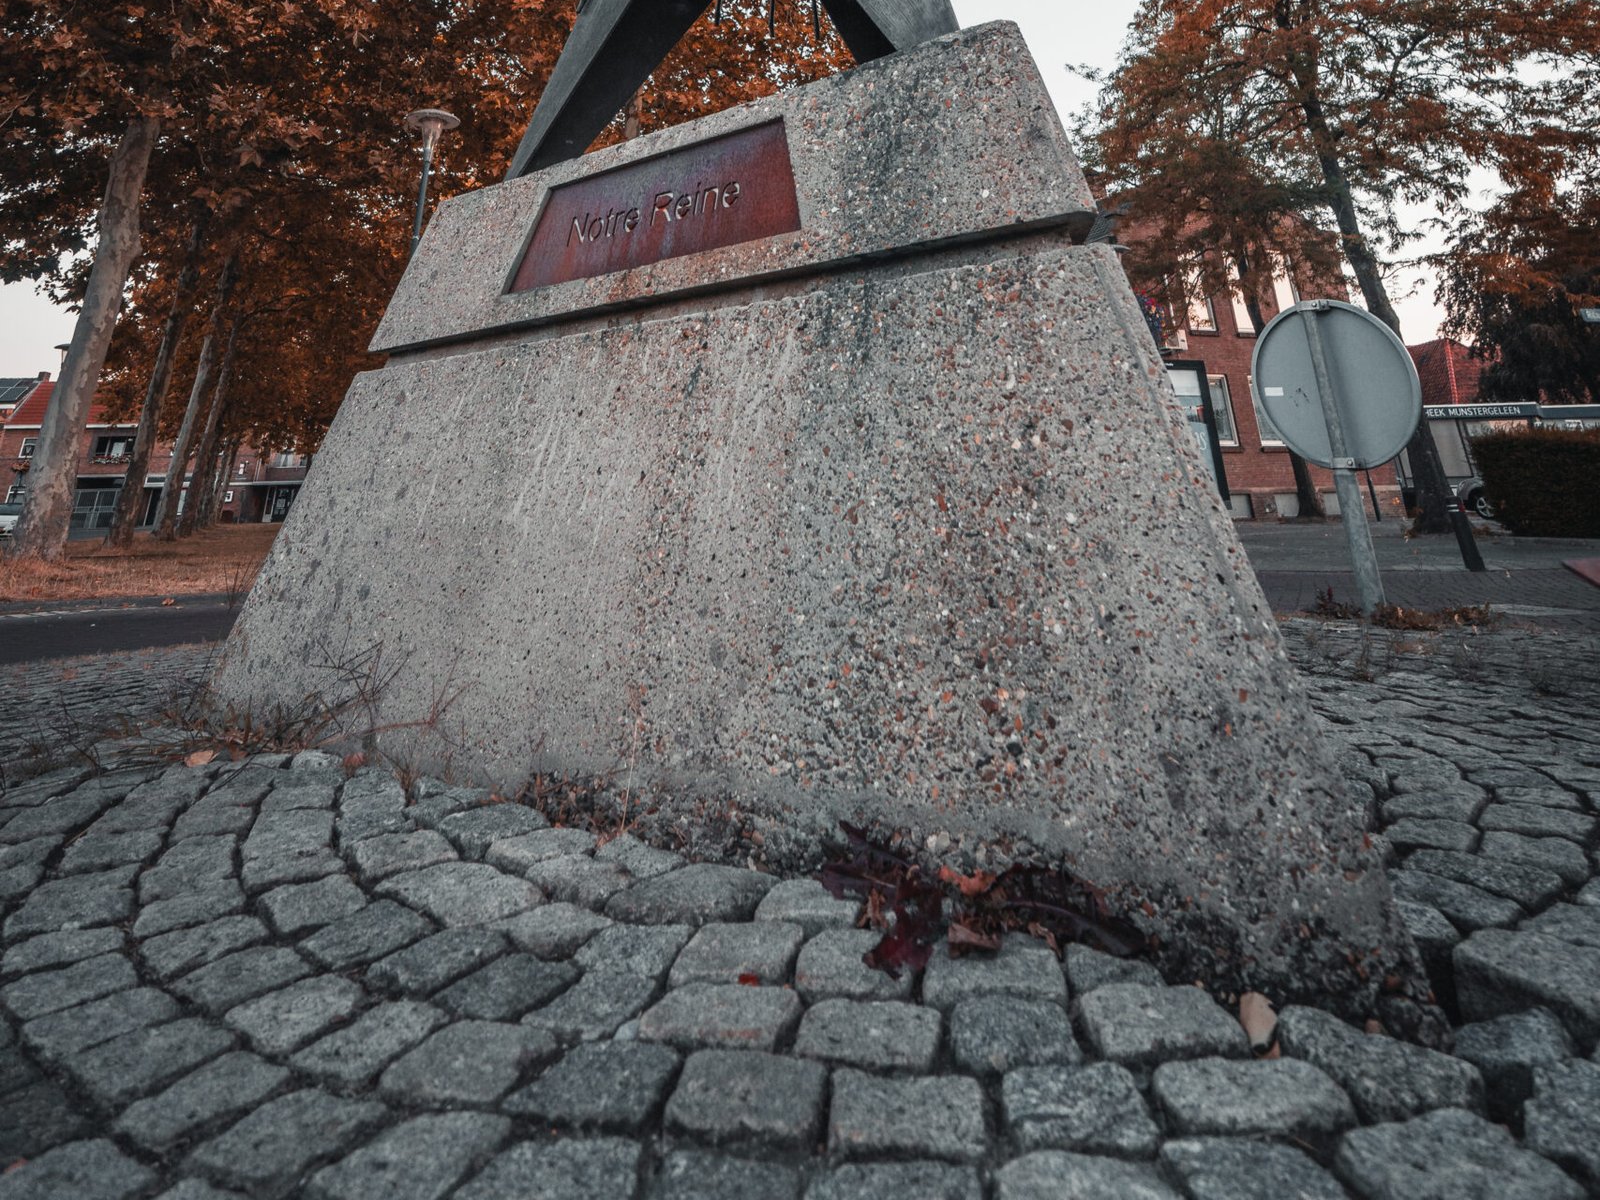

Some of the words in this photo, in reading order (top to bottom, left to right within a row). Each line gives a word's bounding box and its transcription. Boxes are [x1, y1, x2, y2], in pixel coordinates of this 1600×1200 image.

[567, 207, 640, 247] Notre
[650, 180, 740, 226] Reine
[1448, 406, 1521, 416] MUNSTERGELEEN
